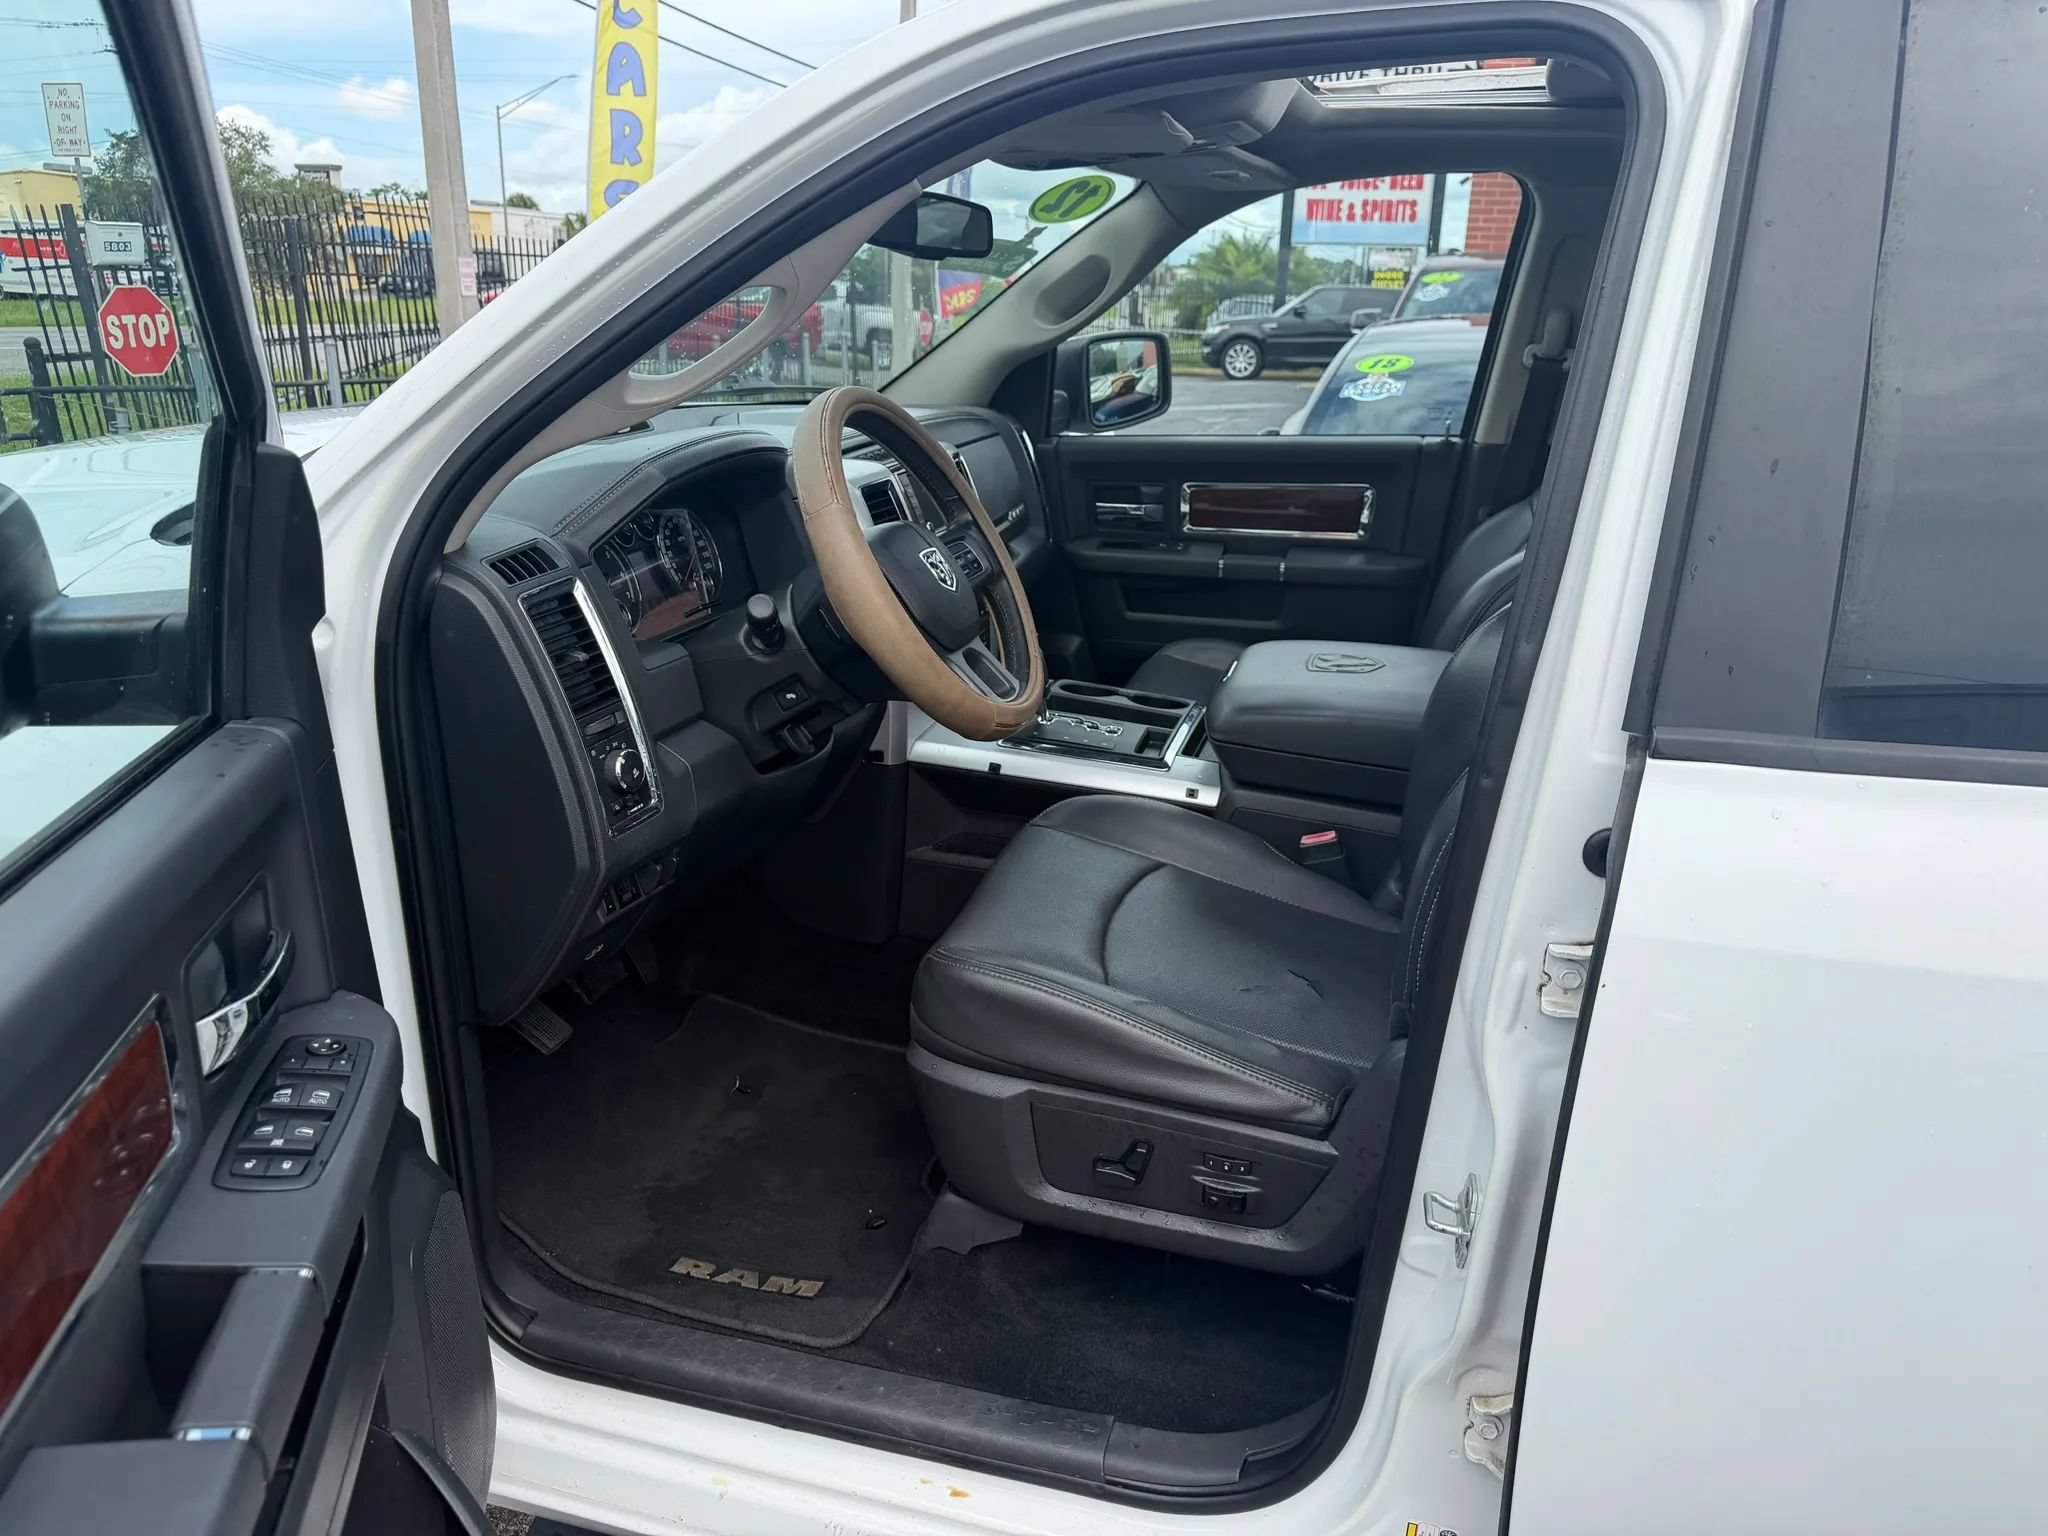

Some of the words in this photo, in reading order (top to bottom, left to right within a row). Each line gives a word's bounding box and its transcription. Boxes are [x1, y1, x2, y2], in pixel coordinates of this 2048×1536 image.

[57, 88, 67, 97] NO
[48, 100, 80, 110] PARKING
[61, 113, 71, 122] ON
[57, 125, 77, 135] RIGHT
[69, 138, 82, 147] WAY
[1306, 199, 1343, 222] WINE
[1346, 202, 1356, 222] &
[1361, 199, 1418, 223] SPIRITS
[104, 241, 132, 251] 5803
[106, 313, 170, 349] STOP
[308, 1097, 328, 1105] AUTO
[667, 1256, 825, 1297] RAM
